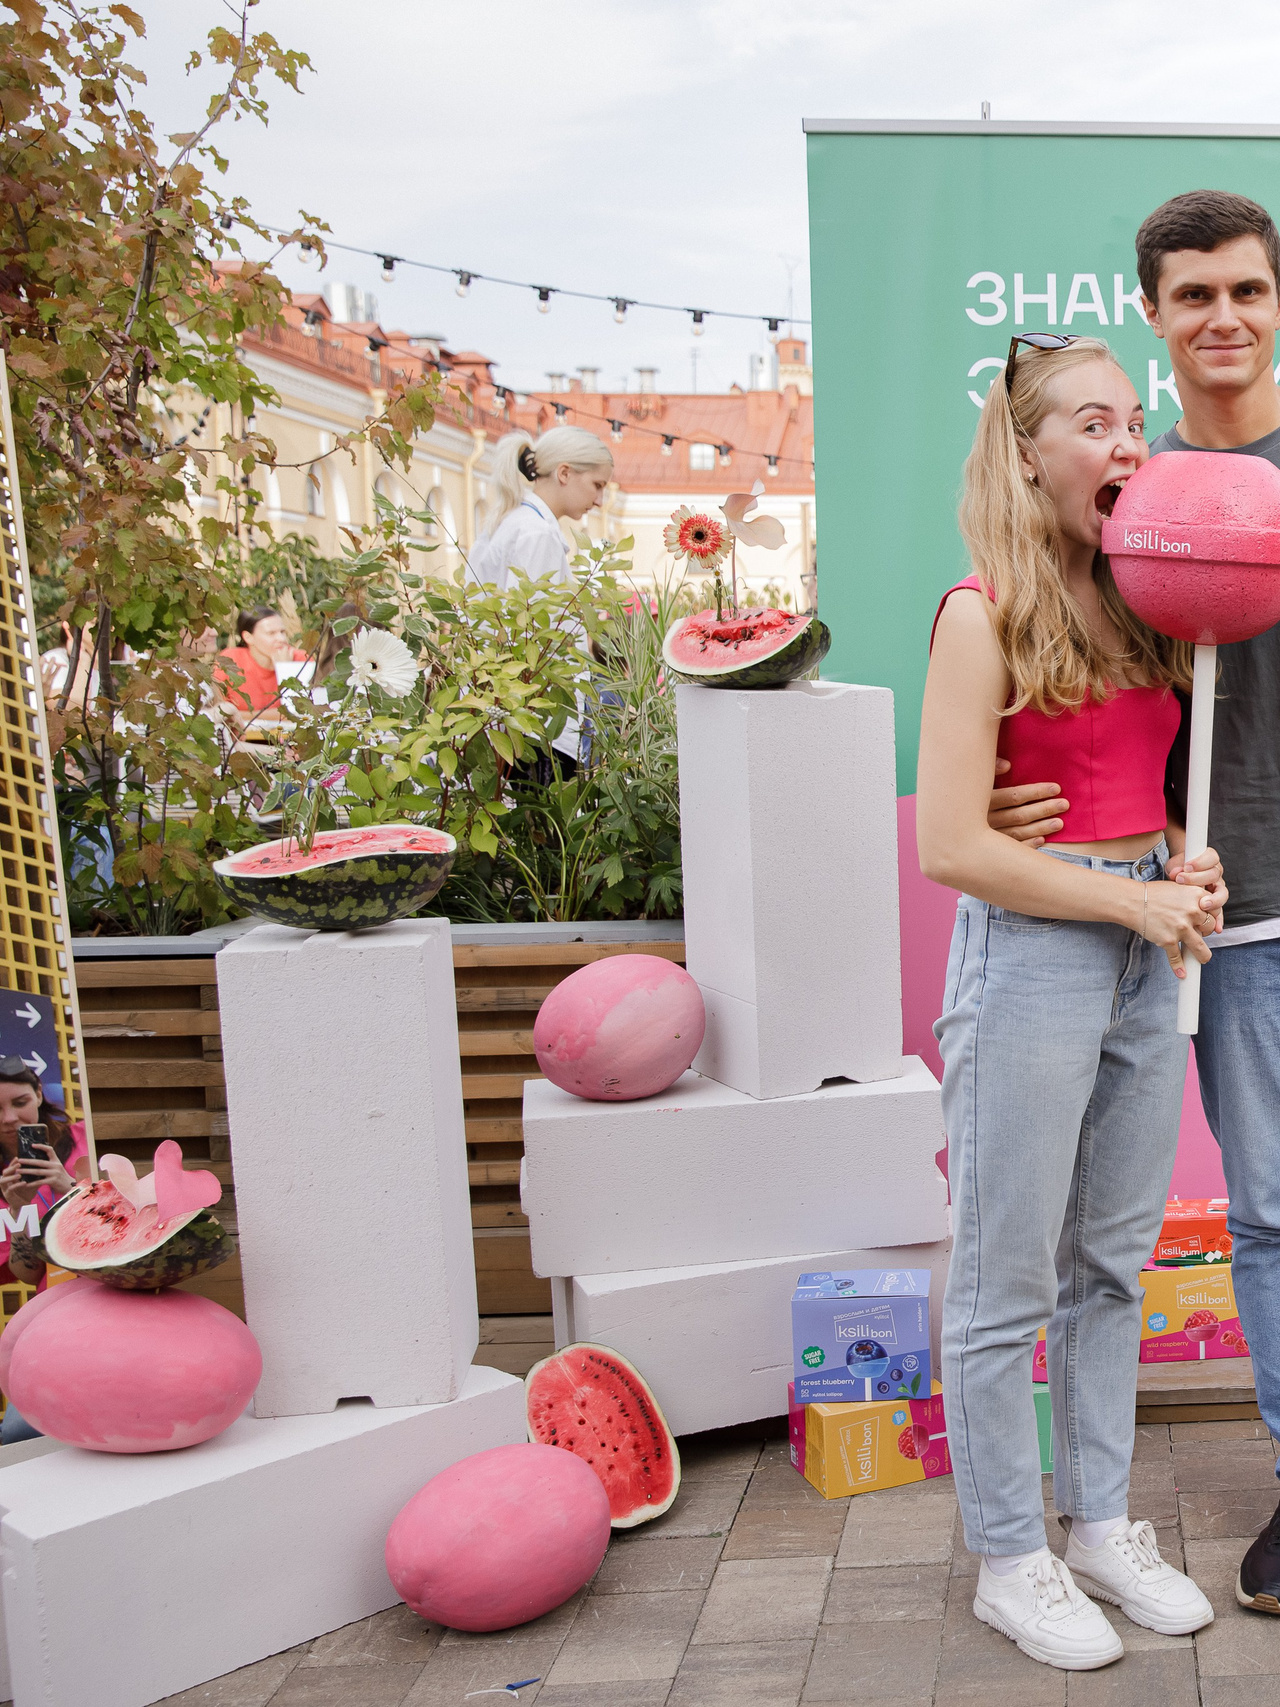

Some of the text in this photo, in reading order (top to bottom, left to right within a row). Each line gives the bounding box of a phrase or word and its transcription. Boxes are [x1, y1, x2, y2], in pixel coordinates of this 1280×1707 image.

[833, 1310, 864, 1320] взрослым
[871, 1304, 890, 1312] детям
[804, 1349, 822, 1360] SUGAR
[808, 1357, 821, 1365] FREE
